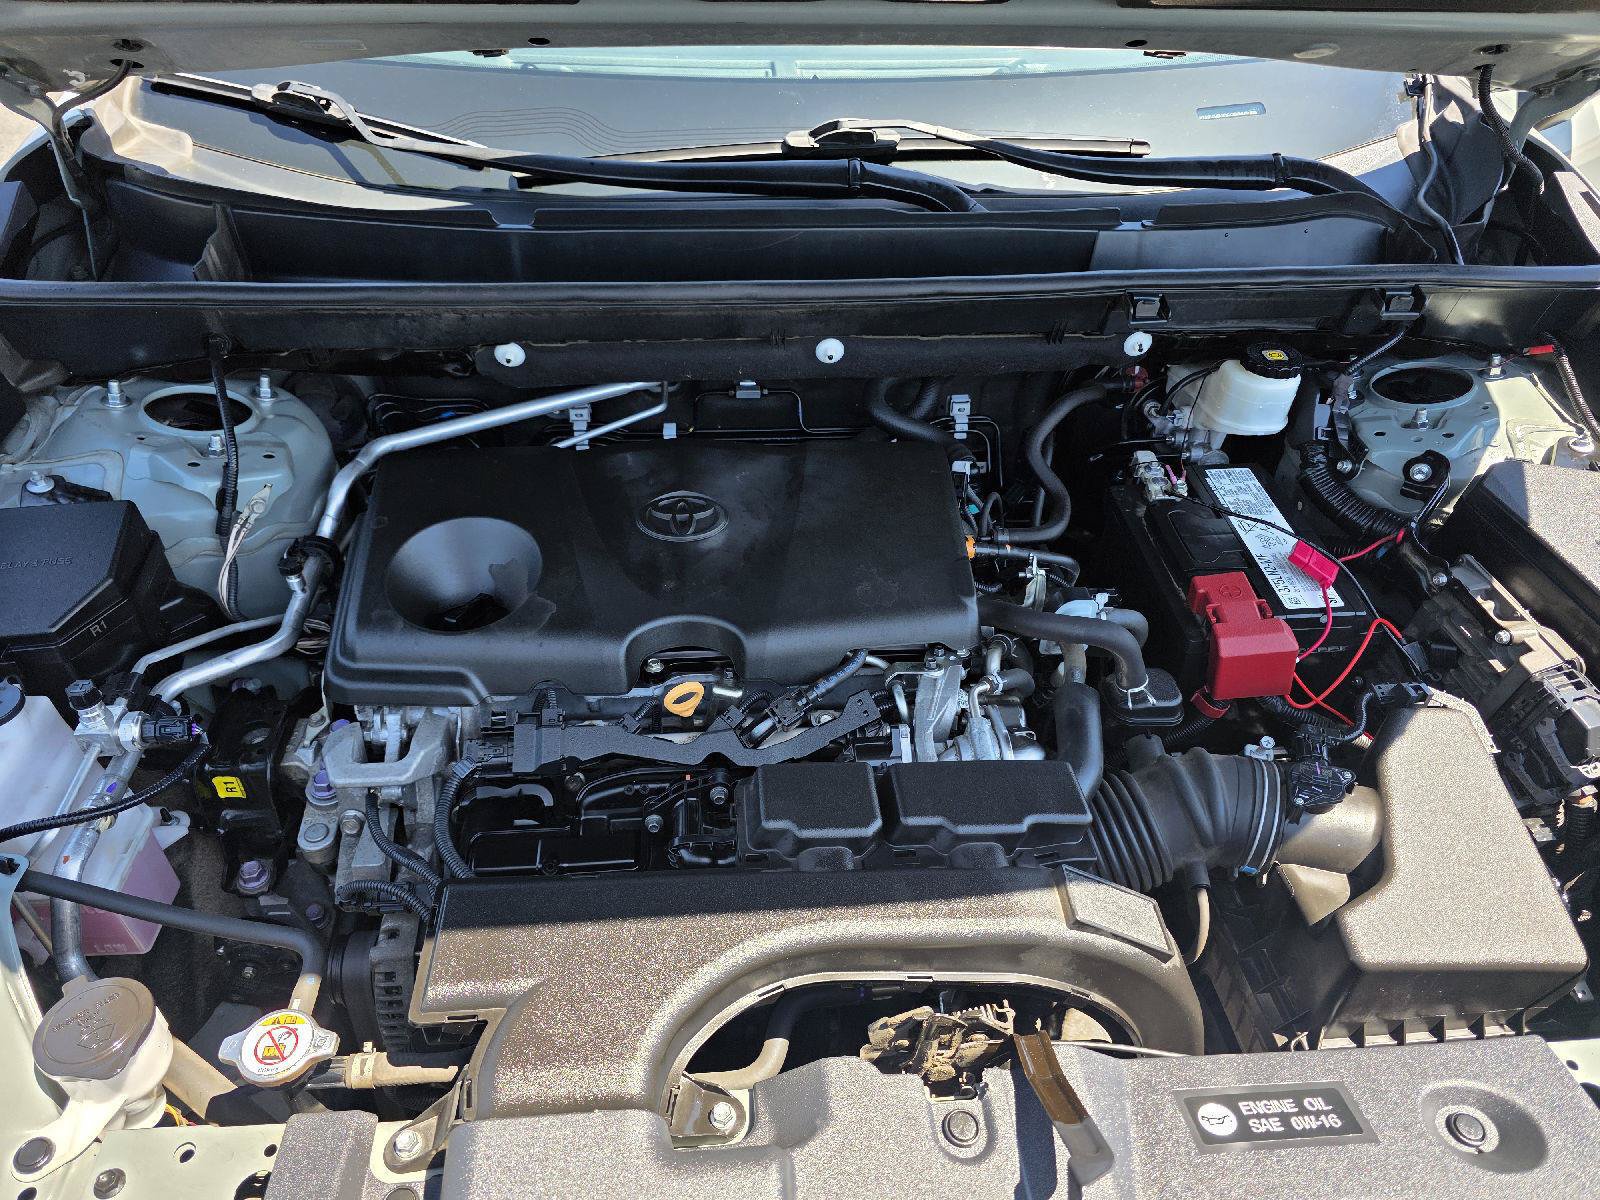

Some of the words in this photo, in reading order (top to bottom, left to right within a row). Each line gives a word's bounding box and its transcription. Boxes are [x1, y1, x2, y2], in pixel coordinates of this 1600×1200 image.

[90, 620, 107, 637] R1
[223, 781, 238, 792] R1
[1238, 1098, 1298, 1115] ENGINE
[1304, 1097, 1332, 1111] OIL
[1248, 1117, 1284, 1133] SAE
[1290, 1114, 1342, 1130] 0W-16
